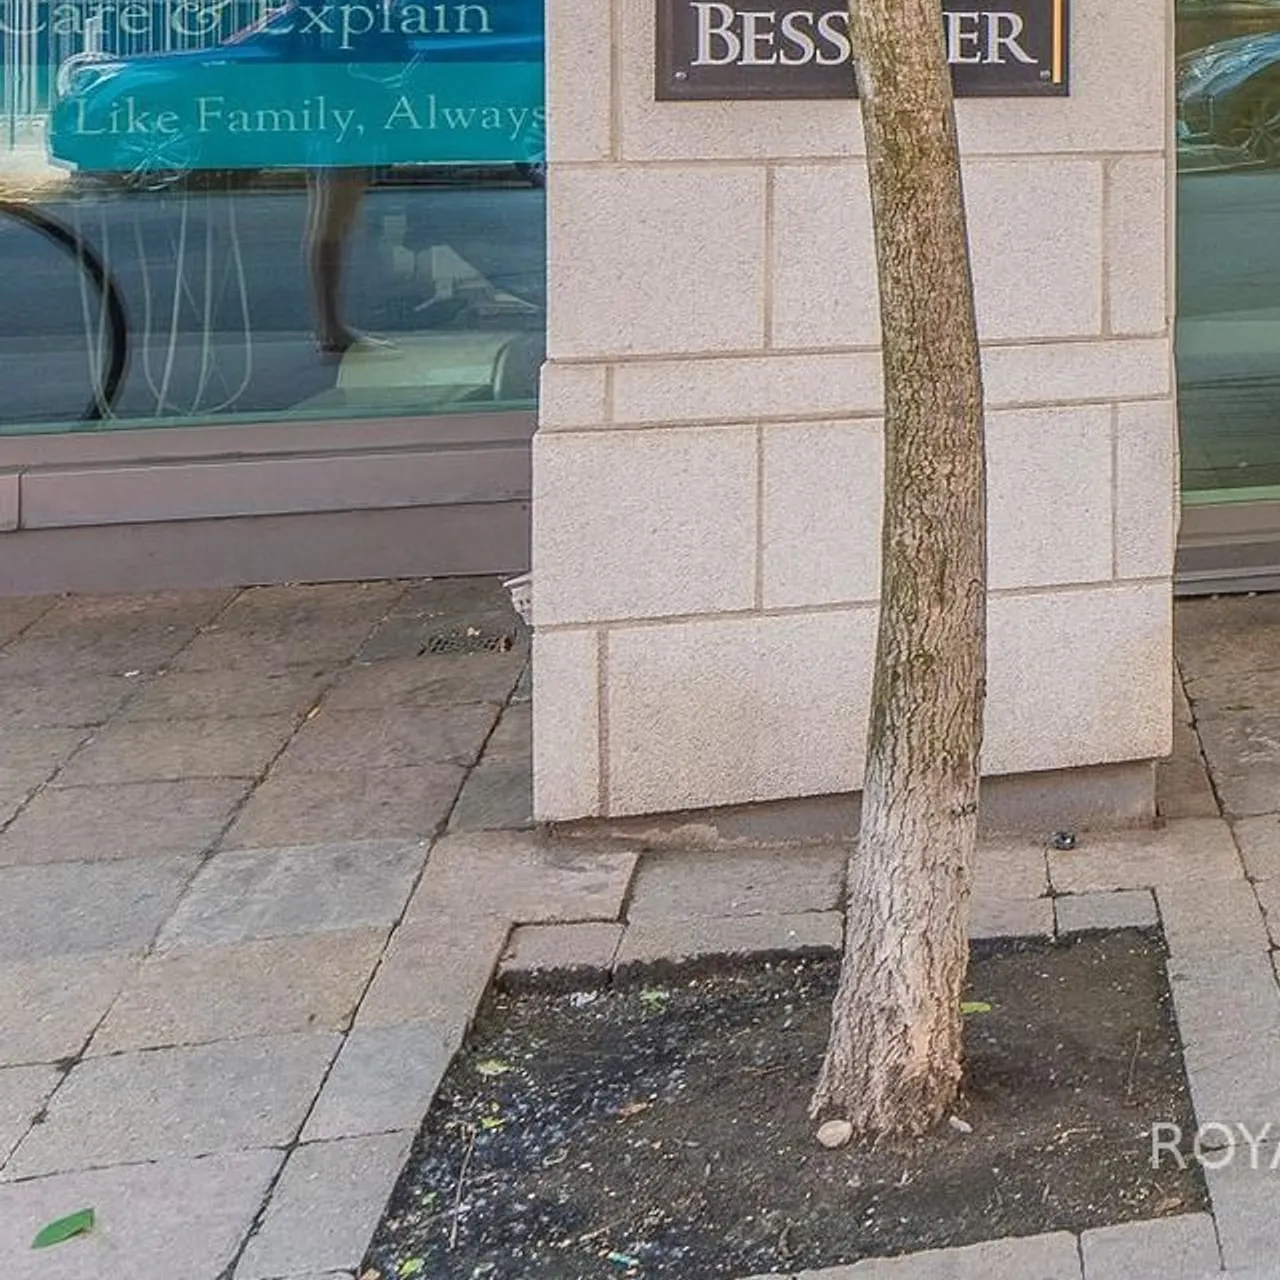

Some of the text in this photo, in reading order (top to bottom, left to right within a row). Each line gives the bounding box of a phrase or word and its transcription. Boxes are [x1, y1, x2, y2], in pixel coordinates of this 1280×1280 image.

[689, 1, 1038, 67] BESSER
[75, 96, 179, 136] Like
[198, 96, 364, 137] Family,
